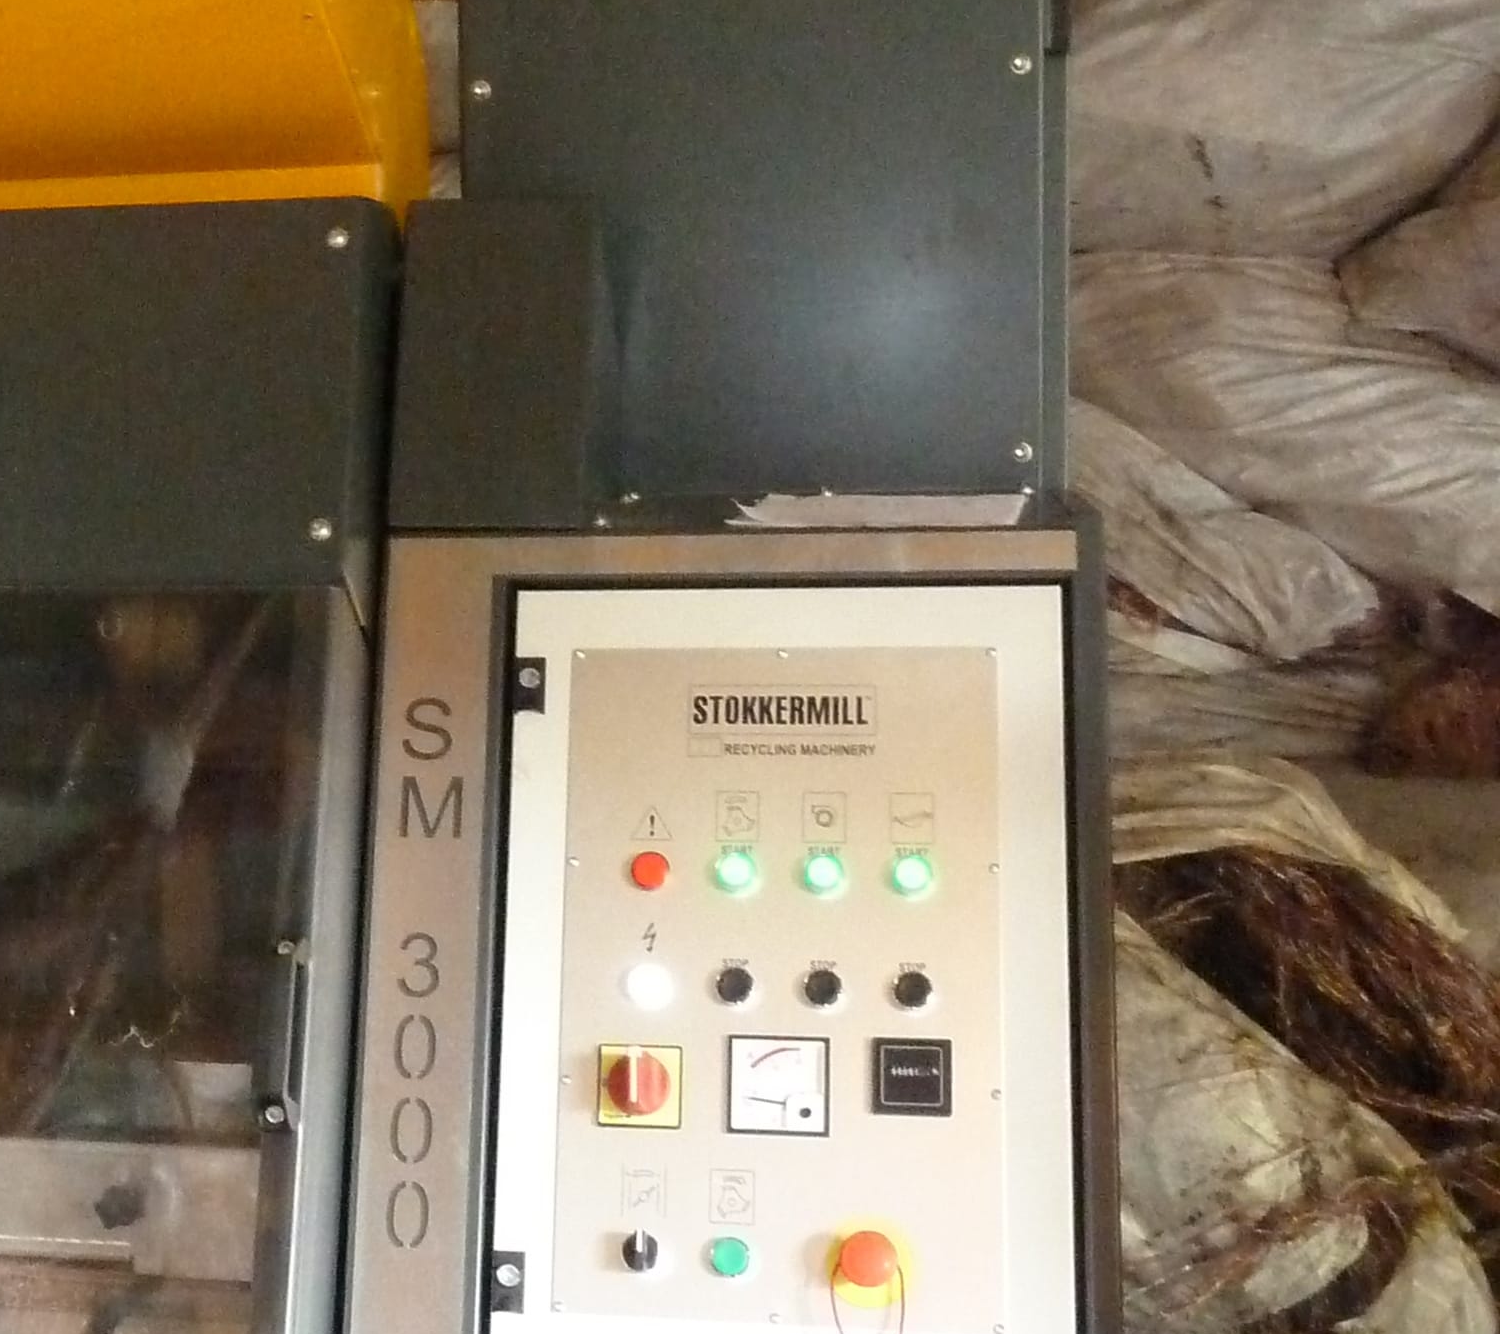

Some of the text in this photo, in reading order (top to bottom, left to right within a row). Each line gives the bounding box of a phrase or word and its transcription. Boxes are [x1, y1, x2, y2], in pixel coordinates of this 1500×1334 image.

[692, 695, 869, 726] STOKKERMILL
[723, 742, 877, 757] RECYCLING MACHINERY
[386, 697, 464, 1248] SM 3000
